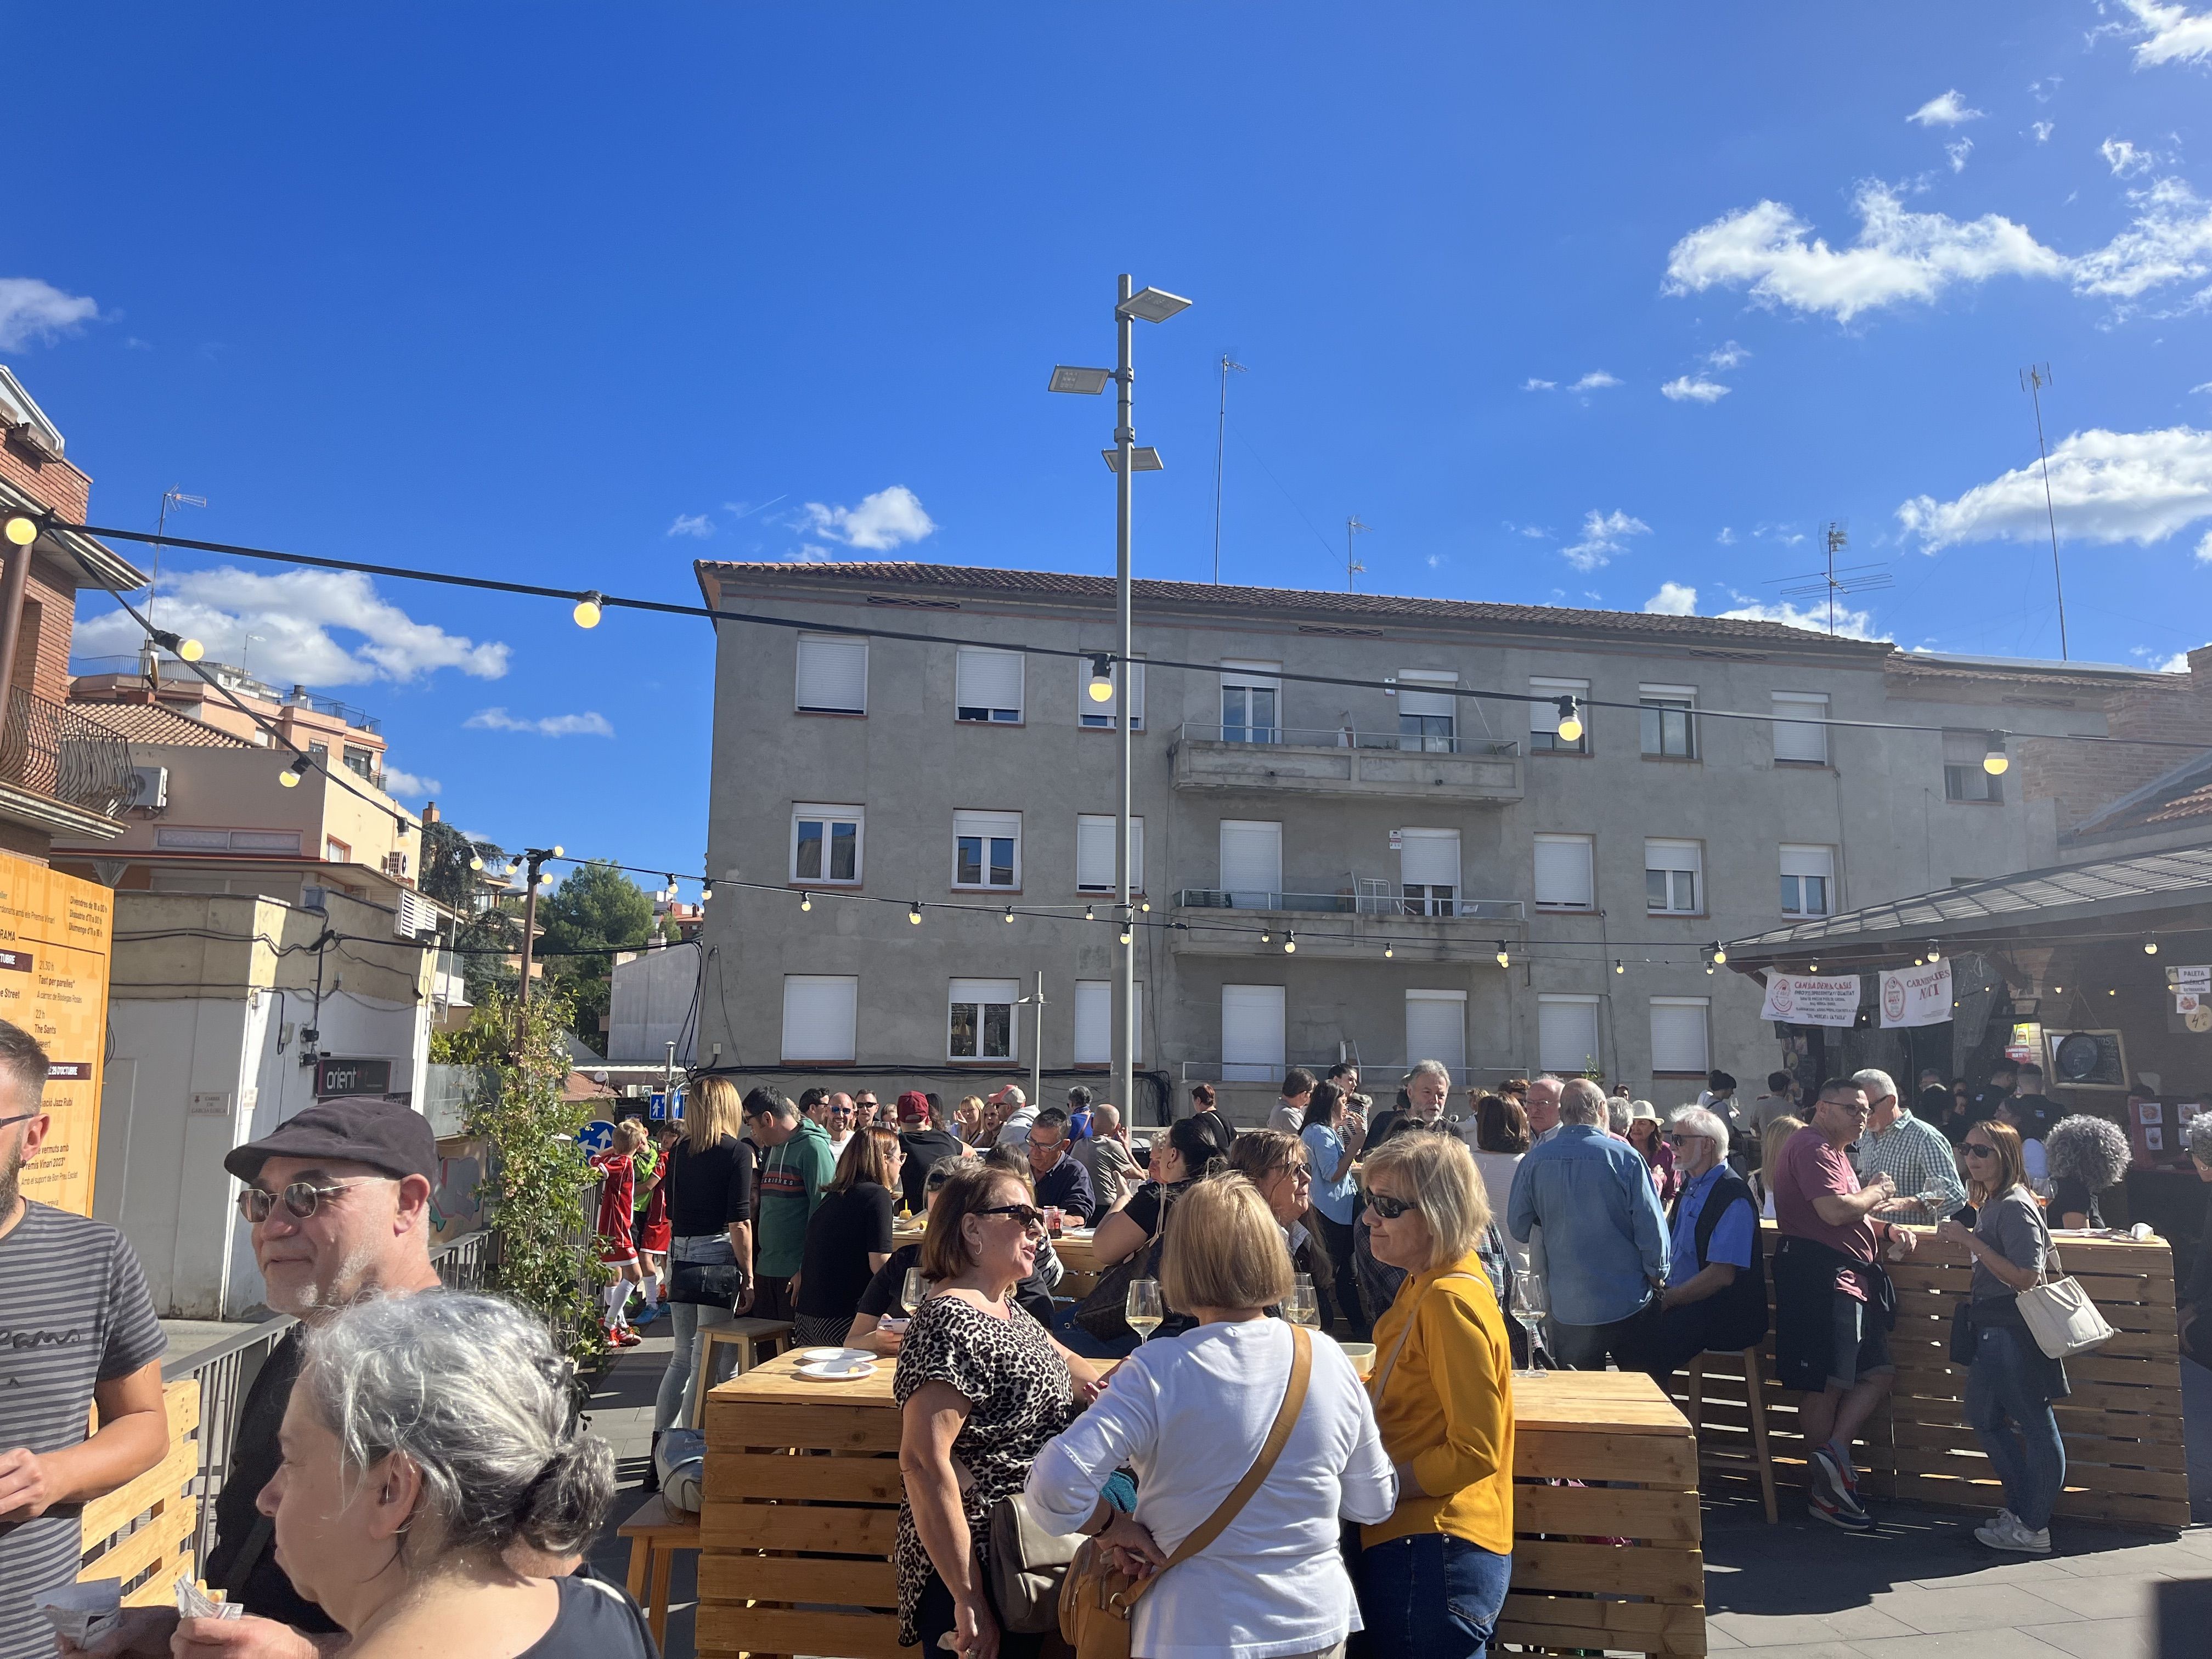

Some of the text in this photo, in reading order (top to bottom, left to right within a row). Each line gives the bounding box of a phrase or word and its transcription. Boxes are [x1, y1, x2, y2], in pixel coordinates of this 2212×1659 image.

[88, 901, 93, 910] de
[31, 911, 44, 922] Premis
[69, 922, 87, 935] Diumenge
[39, 975, 48, 985] Tast
[4, 988, 20, 999] Street
[36, 1009, 45, 1019] 22 h
[2192, 1014, 2199, 1028] 4
[35, 1024, 56, 1034] The Sants
[326, 1066, 357, 1090] orient
[53, 1098, 63, 1107] Jazz
[42, 1144, 59, 1154] vermuts
[60, 1143, 69, 1152] amb
[40, 1159, 53, 1169] Vinari
[35, 1176, 47, 1185] suport
[47, 1174, 52, 1182] de
